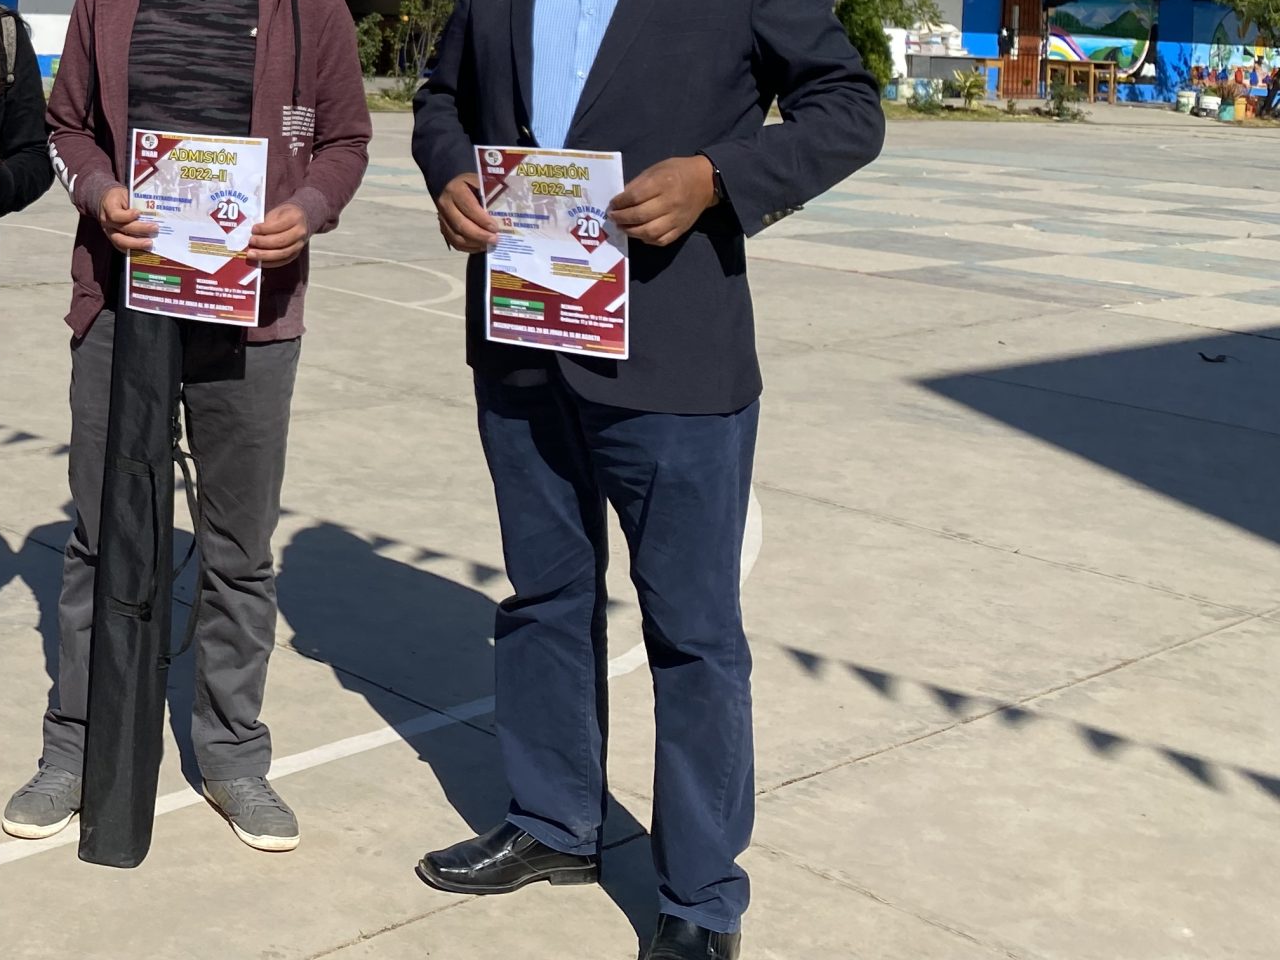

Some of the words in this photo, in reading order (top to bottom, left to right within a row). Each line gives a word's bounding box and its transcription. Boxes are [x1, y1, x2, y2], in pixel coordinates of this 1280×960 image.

[168, 148, 237, 165] ADMISIÓN
[180, 167, 227, 182] 2022-II
[517, 163, 589, 180] ADMISIÓN
[210, 190, 249, 203] ORDINARIO
[531, 181, 582, 198] 2022-II
[217, 202, 239, 220] 20
[577, 218, 601, 238] 20
